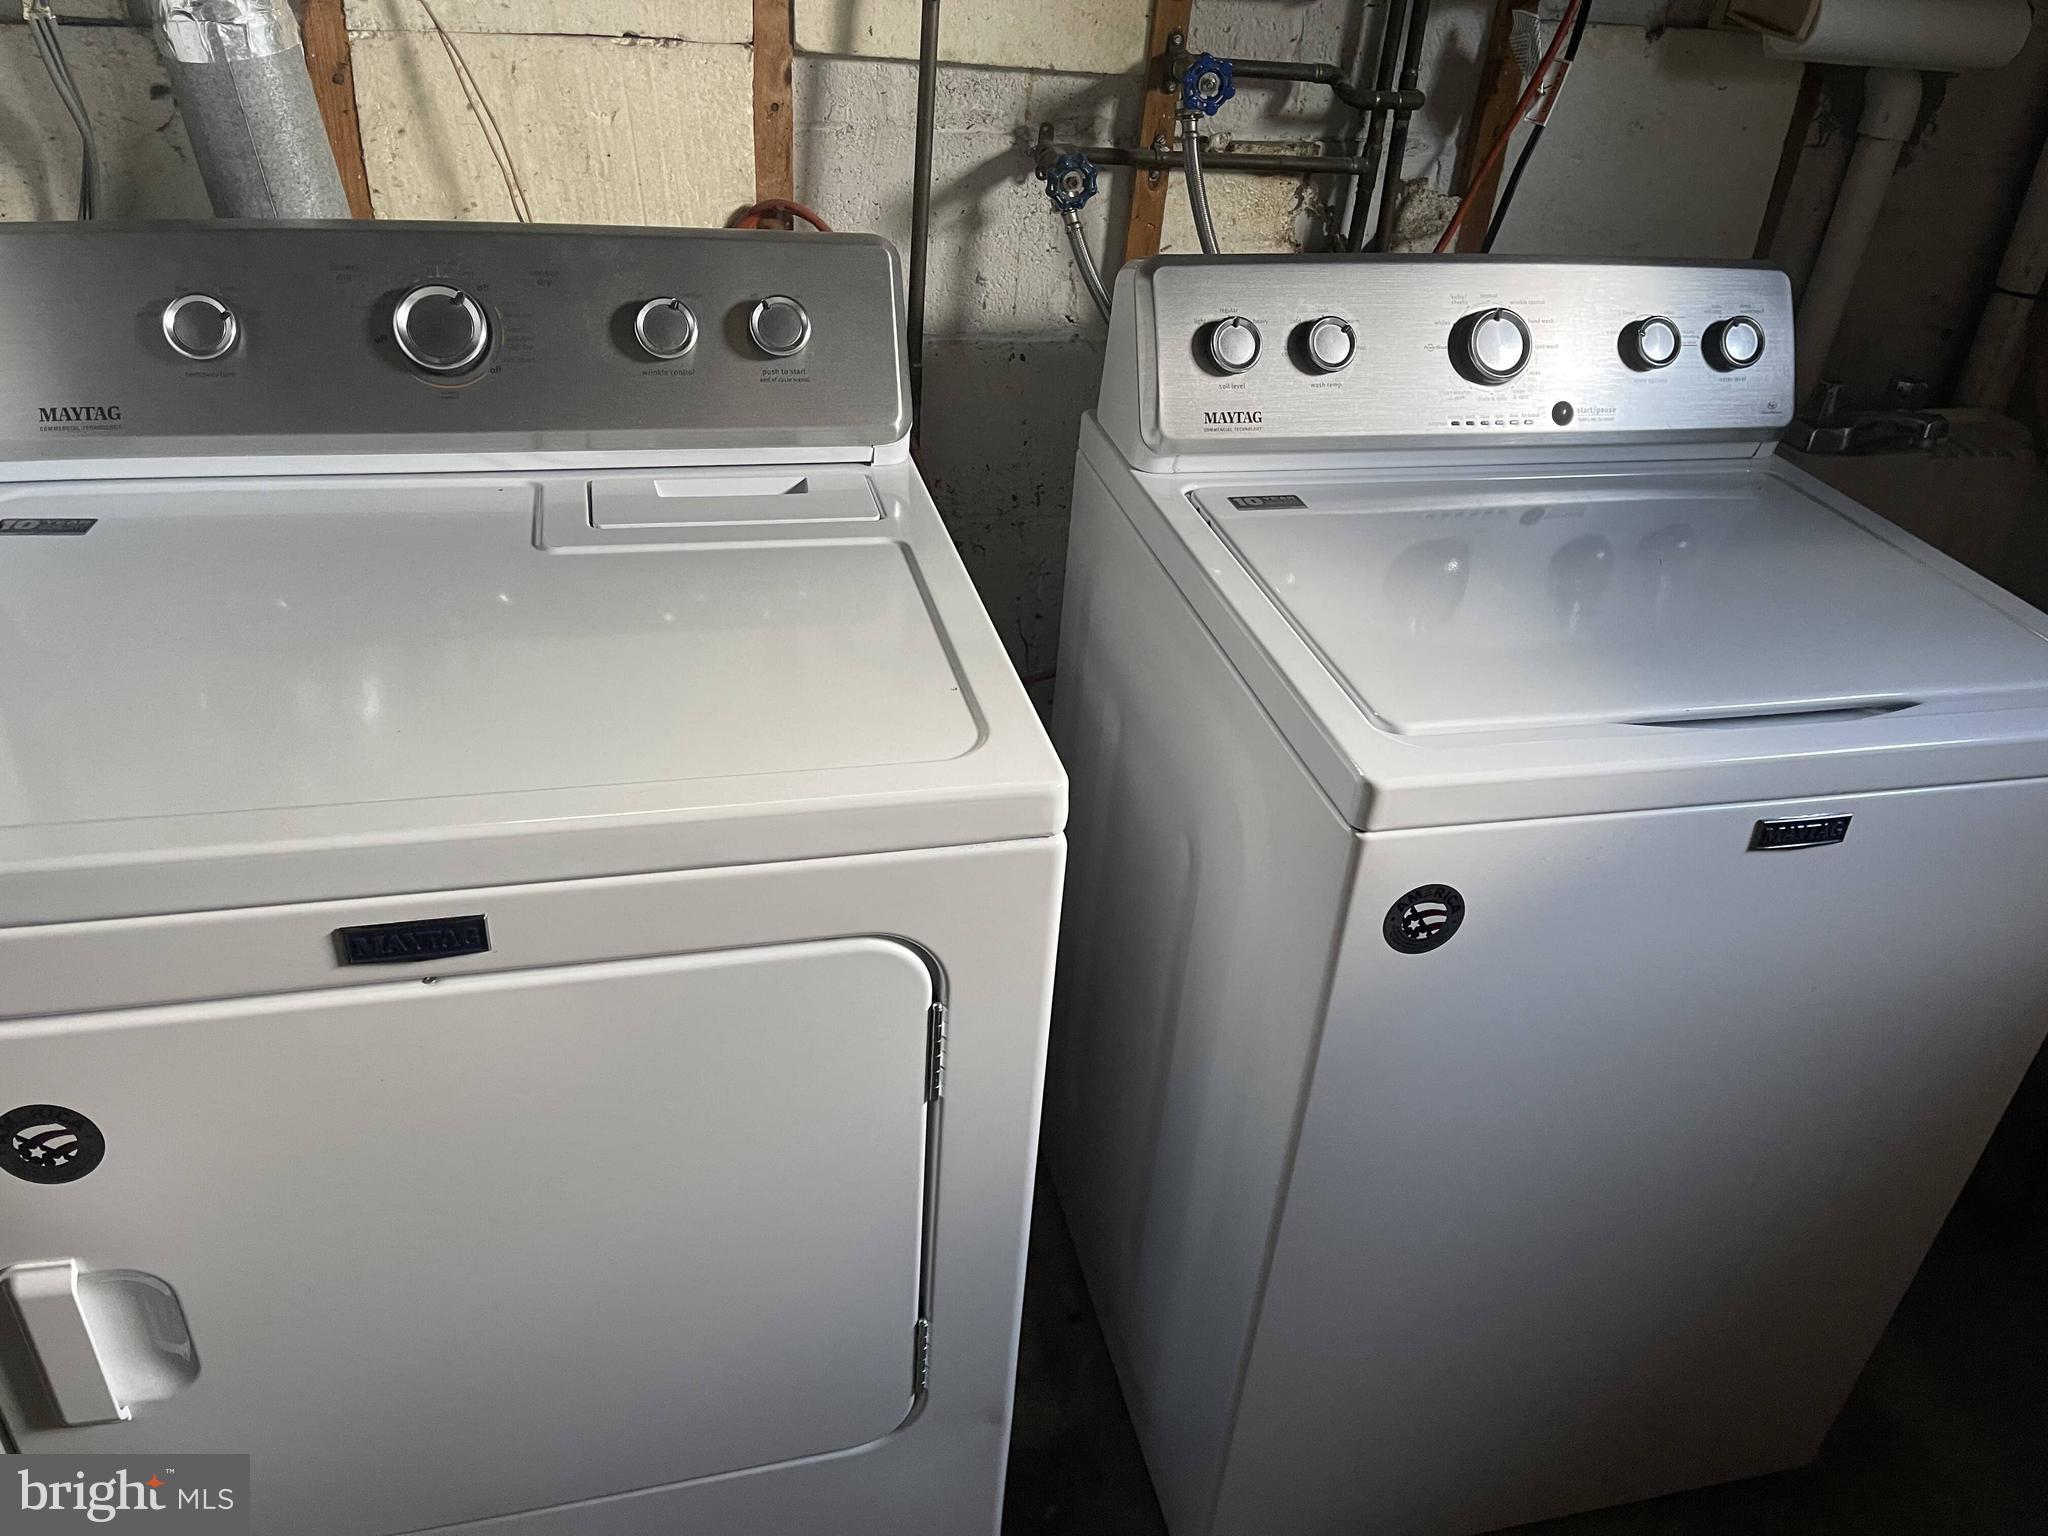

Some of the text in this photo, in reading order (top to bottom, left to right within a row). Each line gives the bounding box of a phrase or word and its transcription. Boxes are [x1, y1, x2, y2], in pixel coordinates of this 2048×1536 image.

[642, 368, 696, 377] wrinkle control
[762, 368, 807, 378] push to start
[1219, 382, 1246, 390] soil level
[1327, 382, 1343, 391] temp
[38, 405, 122, 423] MAYTAG
[1203, 410, 1263, 425] MAYTAG
[351, 926, 481, 956] MAYTAG
